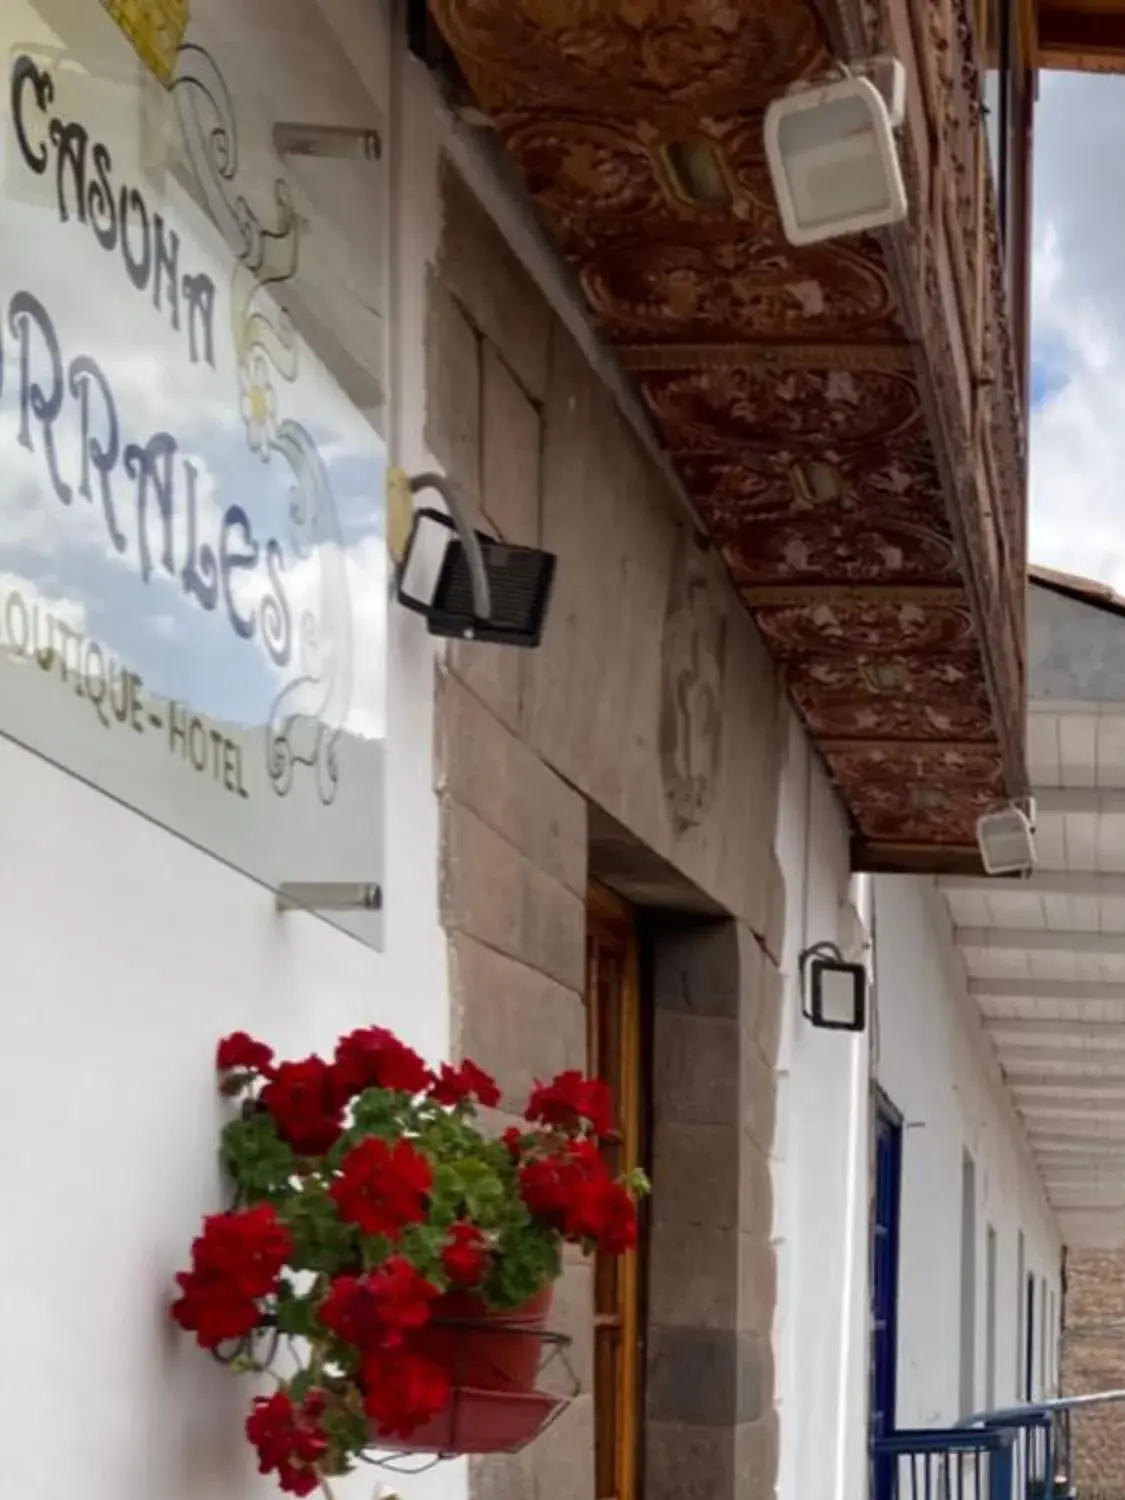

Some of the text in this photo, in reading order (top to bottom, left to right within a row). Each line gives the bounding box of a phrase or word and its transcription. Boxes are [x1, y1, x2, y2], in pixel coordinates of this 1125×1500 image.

[11, 54, 216, 371] CASONA
[0, 290, 293, 667] RRALES
[1, 590, 249, 799] OUTIQUE-HOTEL
